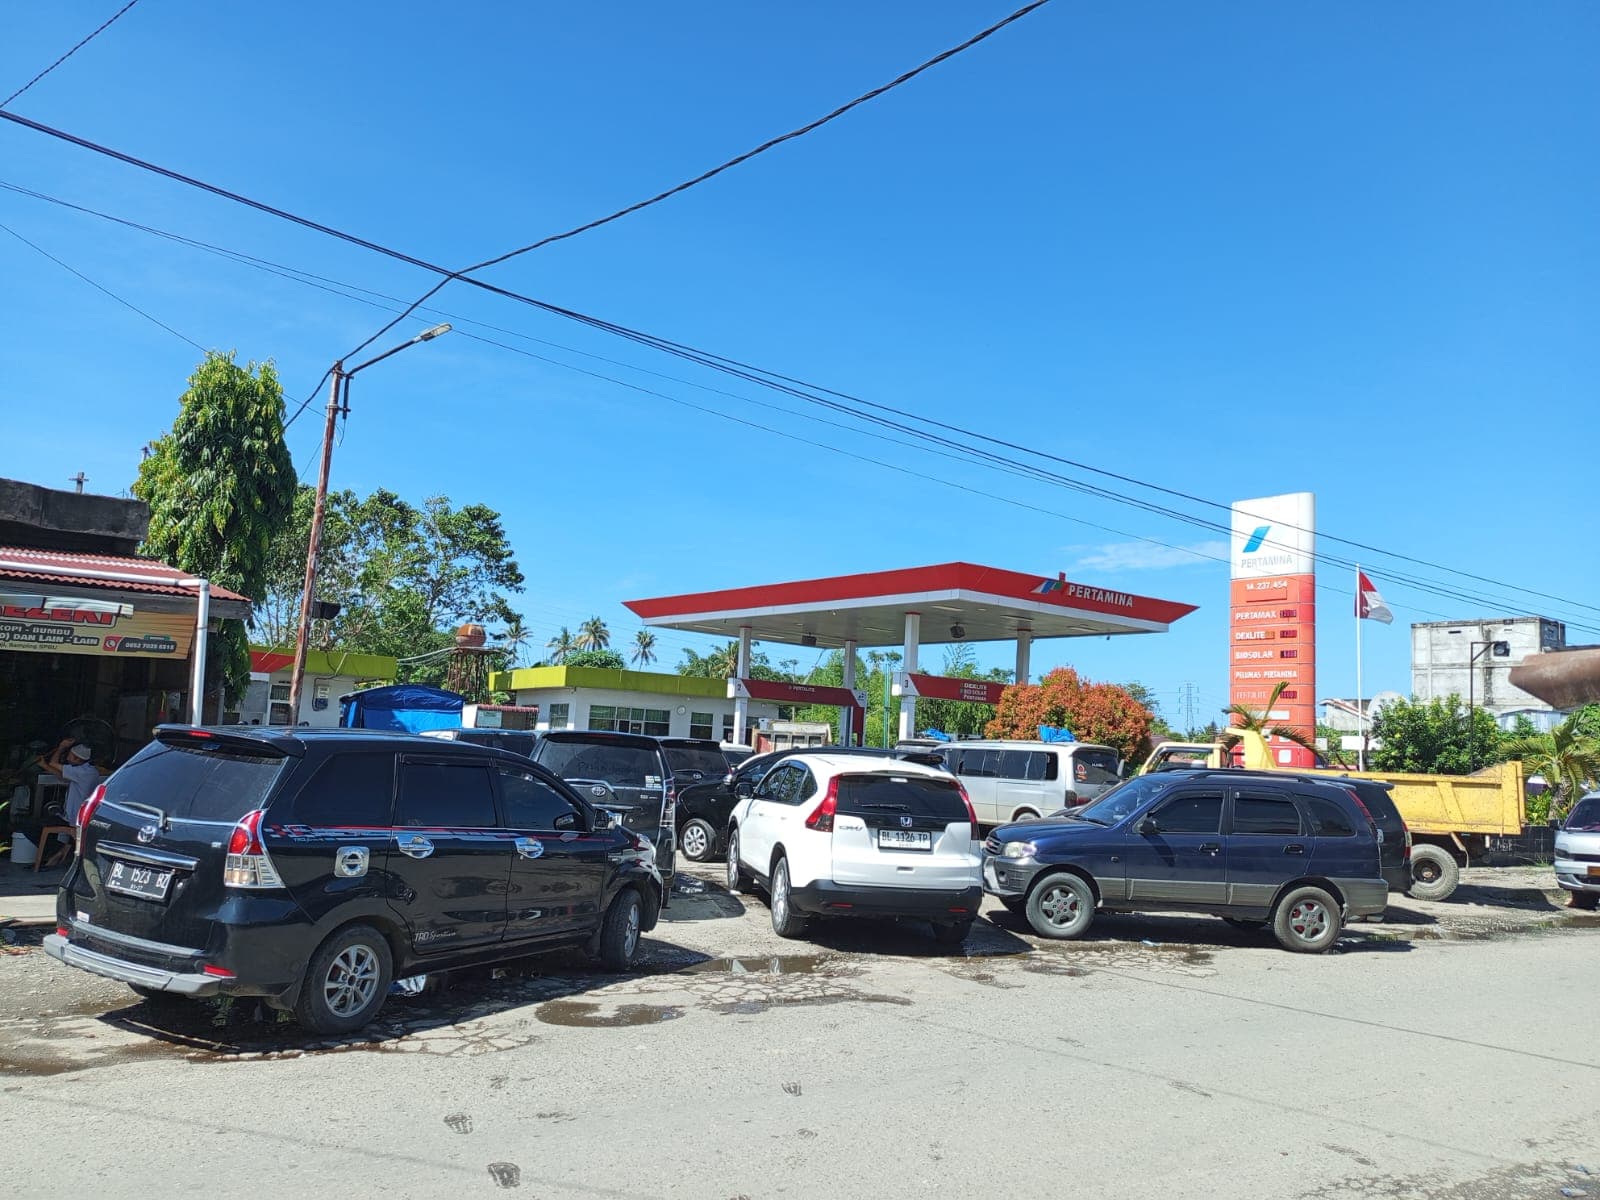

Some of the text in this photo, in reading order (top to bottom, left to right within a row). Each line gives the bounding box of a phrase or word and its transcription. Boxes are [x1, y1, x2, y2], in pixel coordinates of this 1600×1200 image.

[1241, 555, 1293, 568] PERTAMINA
[1067, 584, 1134, 607] PERTAMINA
[1236, 611, 1277, 619] PERTAMAX
[13, 633, 36, 641] DAN
[39, 635, 64, 643] LAIN
[73, 637, 98, 645] LAIN
[1236, 631, 1266, 640] DEXLITE
[1235, 651, 1273, 659] BIOSOLAR
[1263, 670, 1298, 678] PERTAMINA
[882, 831, 928, 844] BL 1126 TP
[112, 862, 125, 879] BL
[131, 868, 152, 885] 1523
[415, 932, 430, 941] TRD
